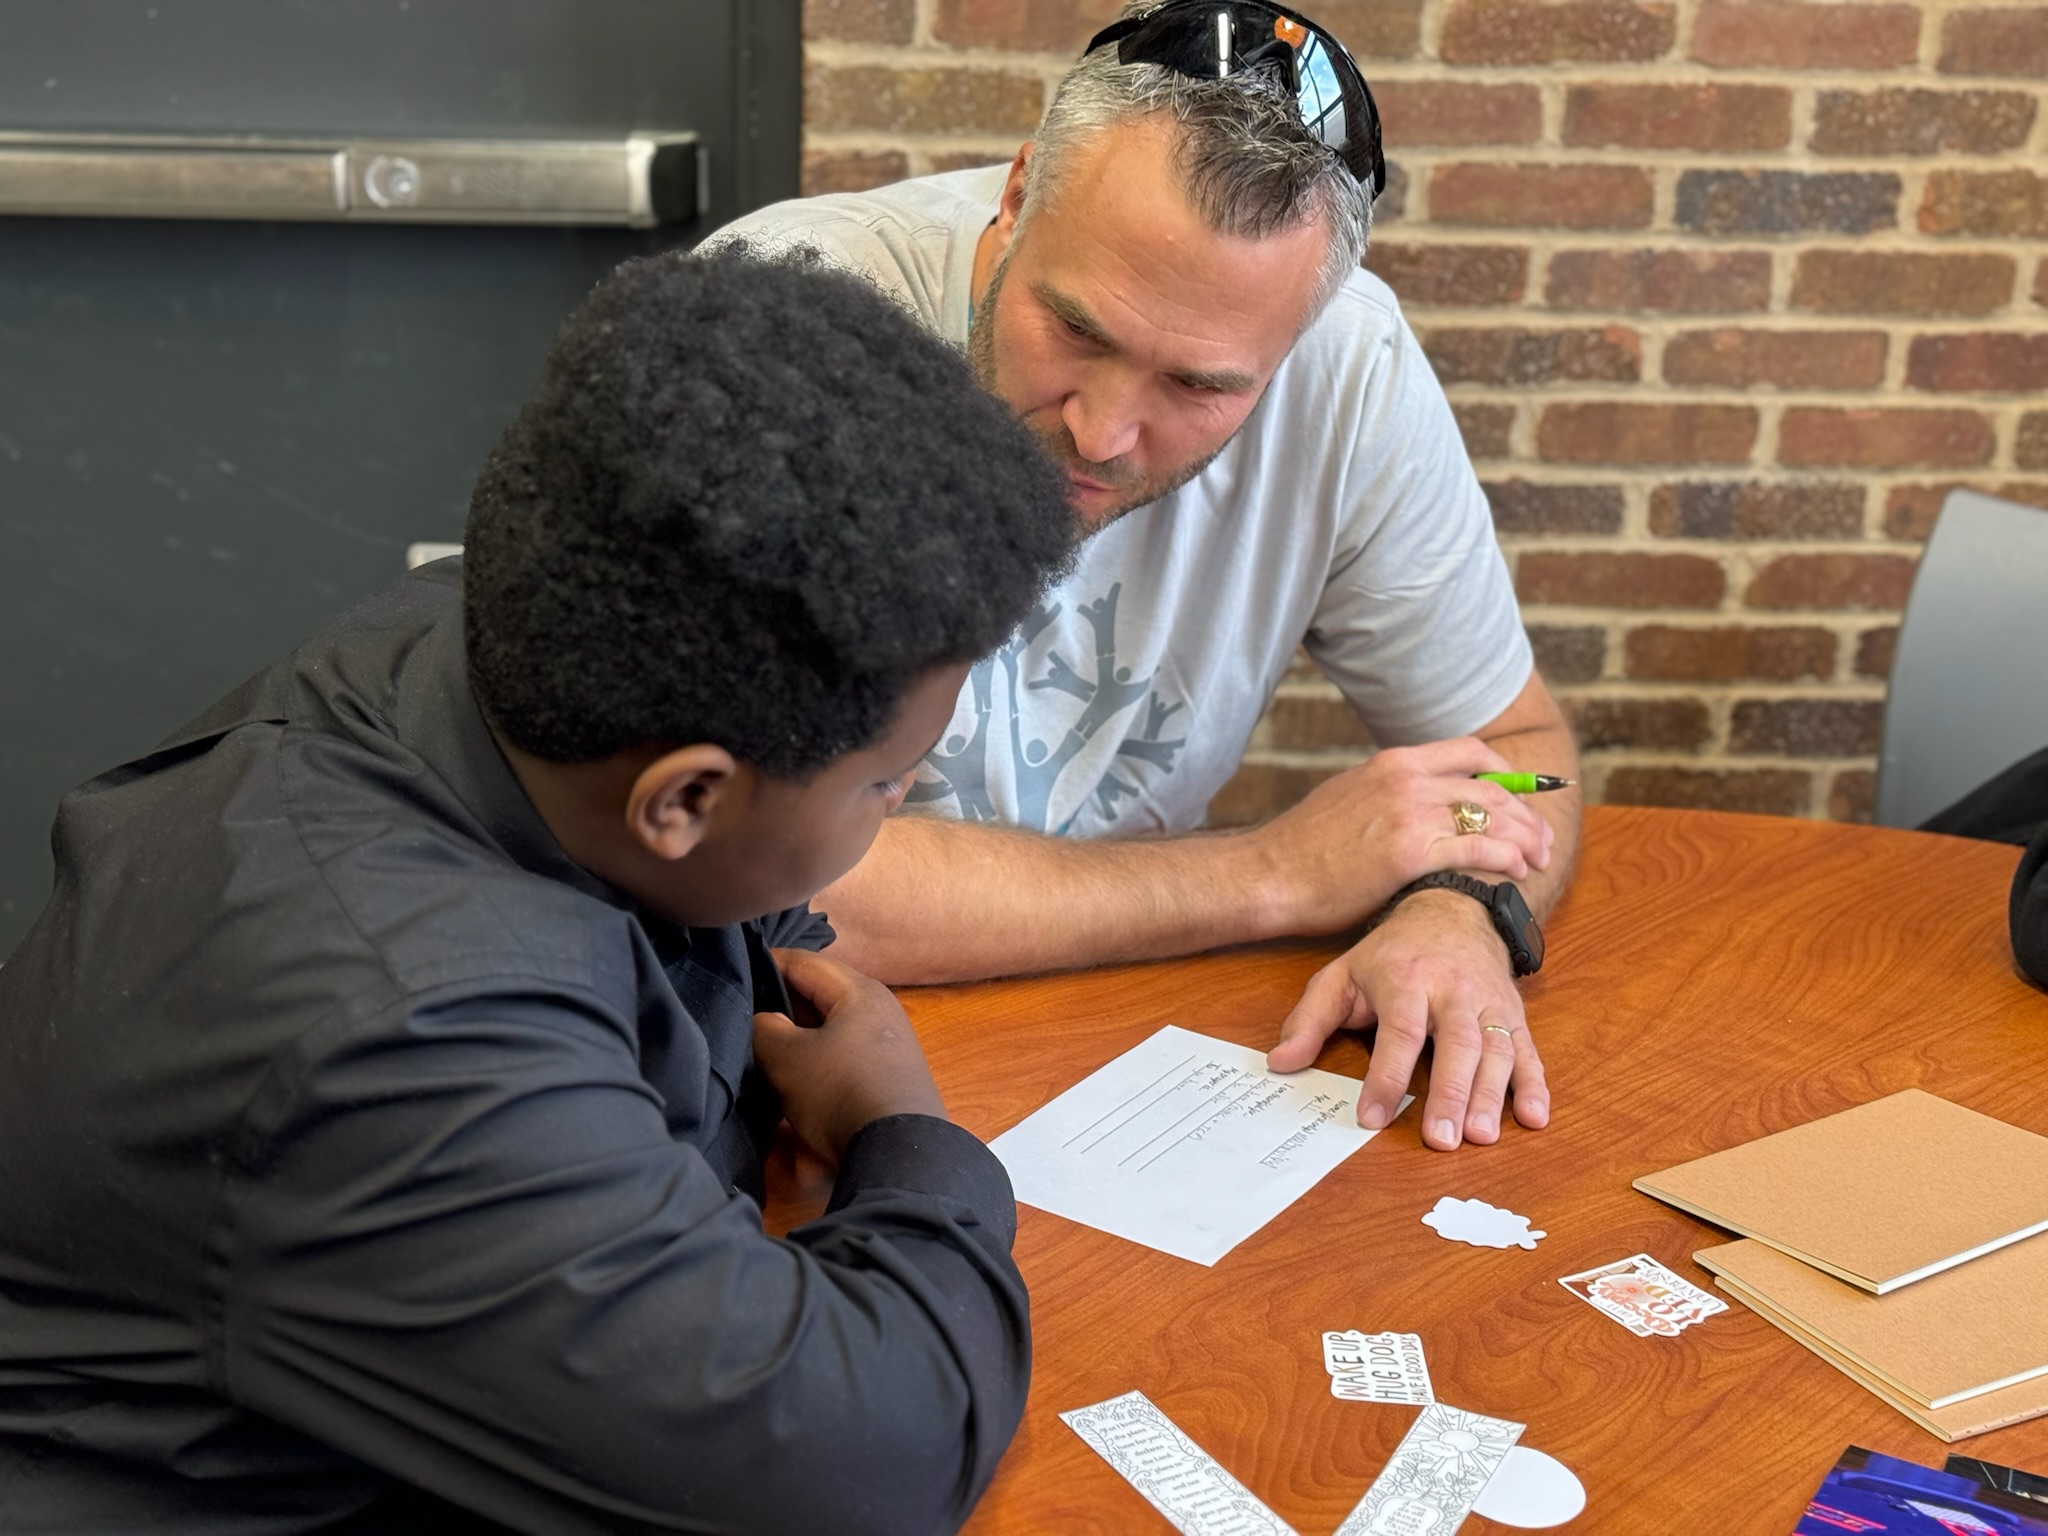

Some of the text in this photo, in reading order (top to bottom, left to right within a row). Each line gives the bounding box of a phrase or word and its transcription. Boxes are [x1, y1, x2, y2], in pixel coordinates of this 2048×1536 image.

[1328, 1332, 1371, 1397] WAKE UP.
[1365, 1333, 1409, 1400] HUG DOG.
[1408, 1382, 1431, 1402] HAVE
